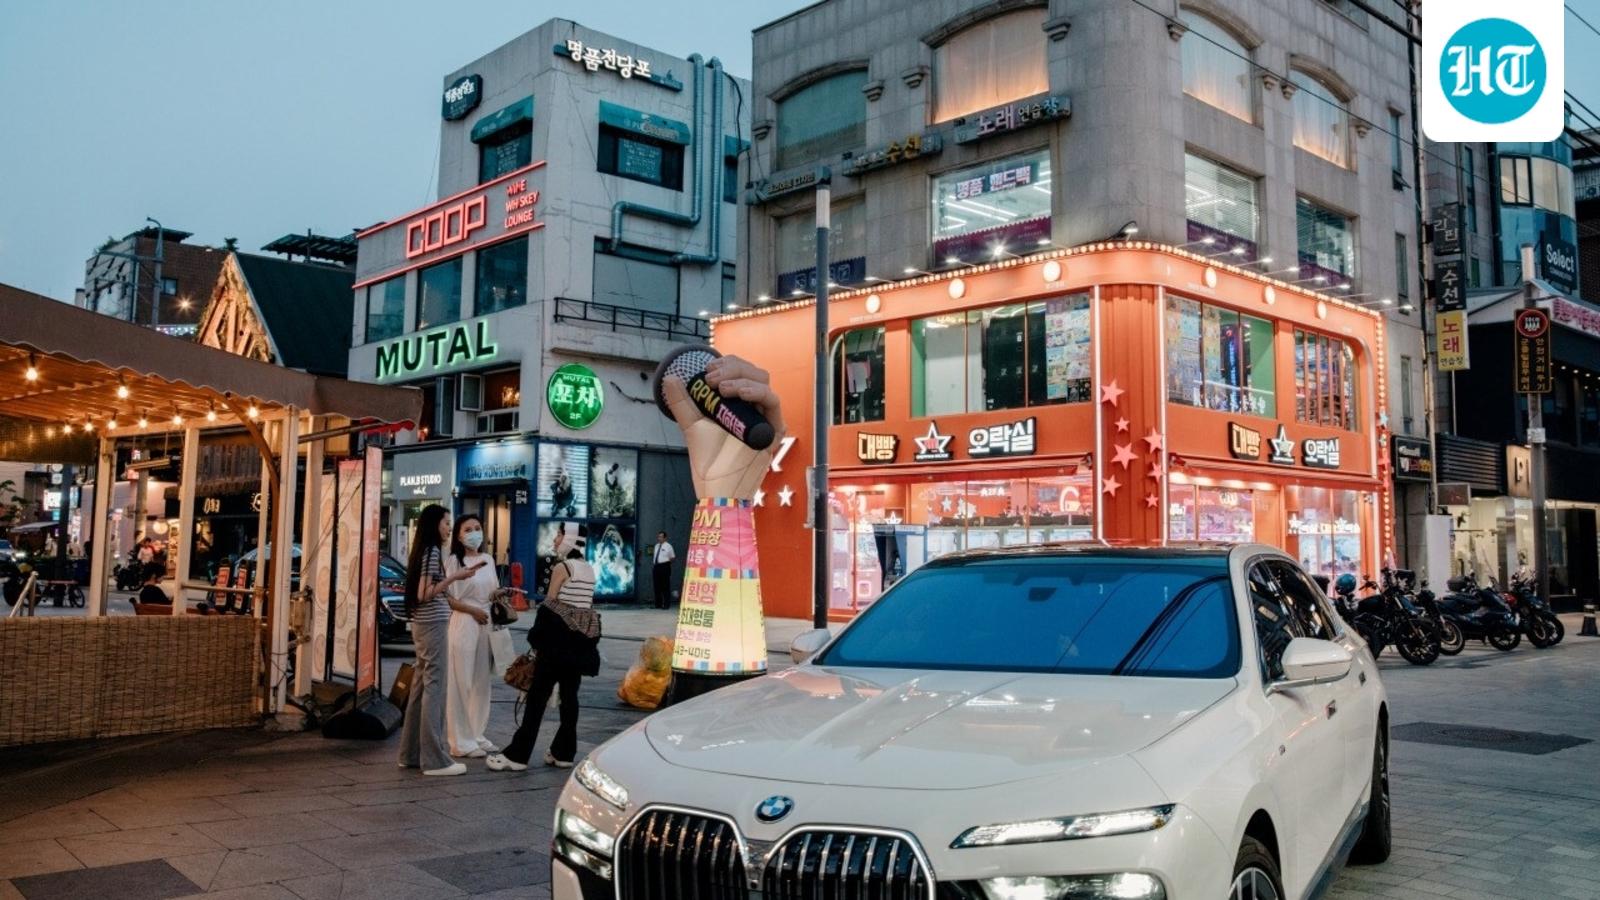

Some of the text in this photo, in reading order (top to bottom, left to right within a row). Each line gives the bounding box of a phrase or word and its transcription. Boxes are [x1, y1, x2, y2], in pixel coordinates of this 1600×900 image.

[566, 39, 652, 79] 명품전당포
[977, 97, 1059, 136] 노래 연습장
[406, 195, 486, 259] COOP
[504, 209, 535, 229] LOUNGE
[1546, 243, 1575, 273] Select
[1442, 269, 1460, 304] 수선
[375, 321, 497, 379] MUTAL
[1442, 318, 1460, 353] 노래
[562, 373, 591, 384] MUTAL
[569, 412, 582, 420] 2F
[690, 379, 721, 417] RPM
[857, 418, 1034, 460] 대빵 오락실
[1231, 423, 1341, 467] 대빵 오락실
[688, 582, 717, 604] 환영
